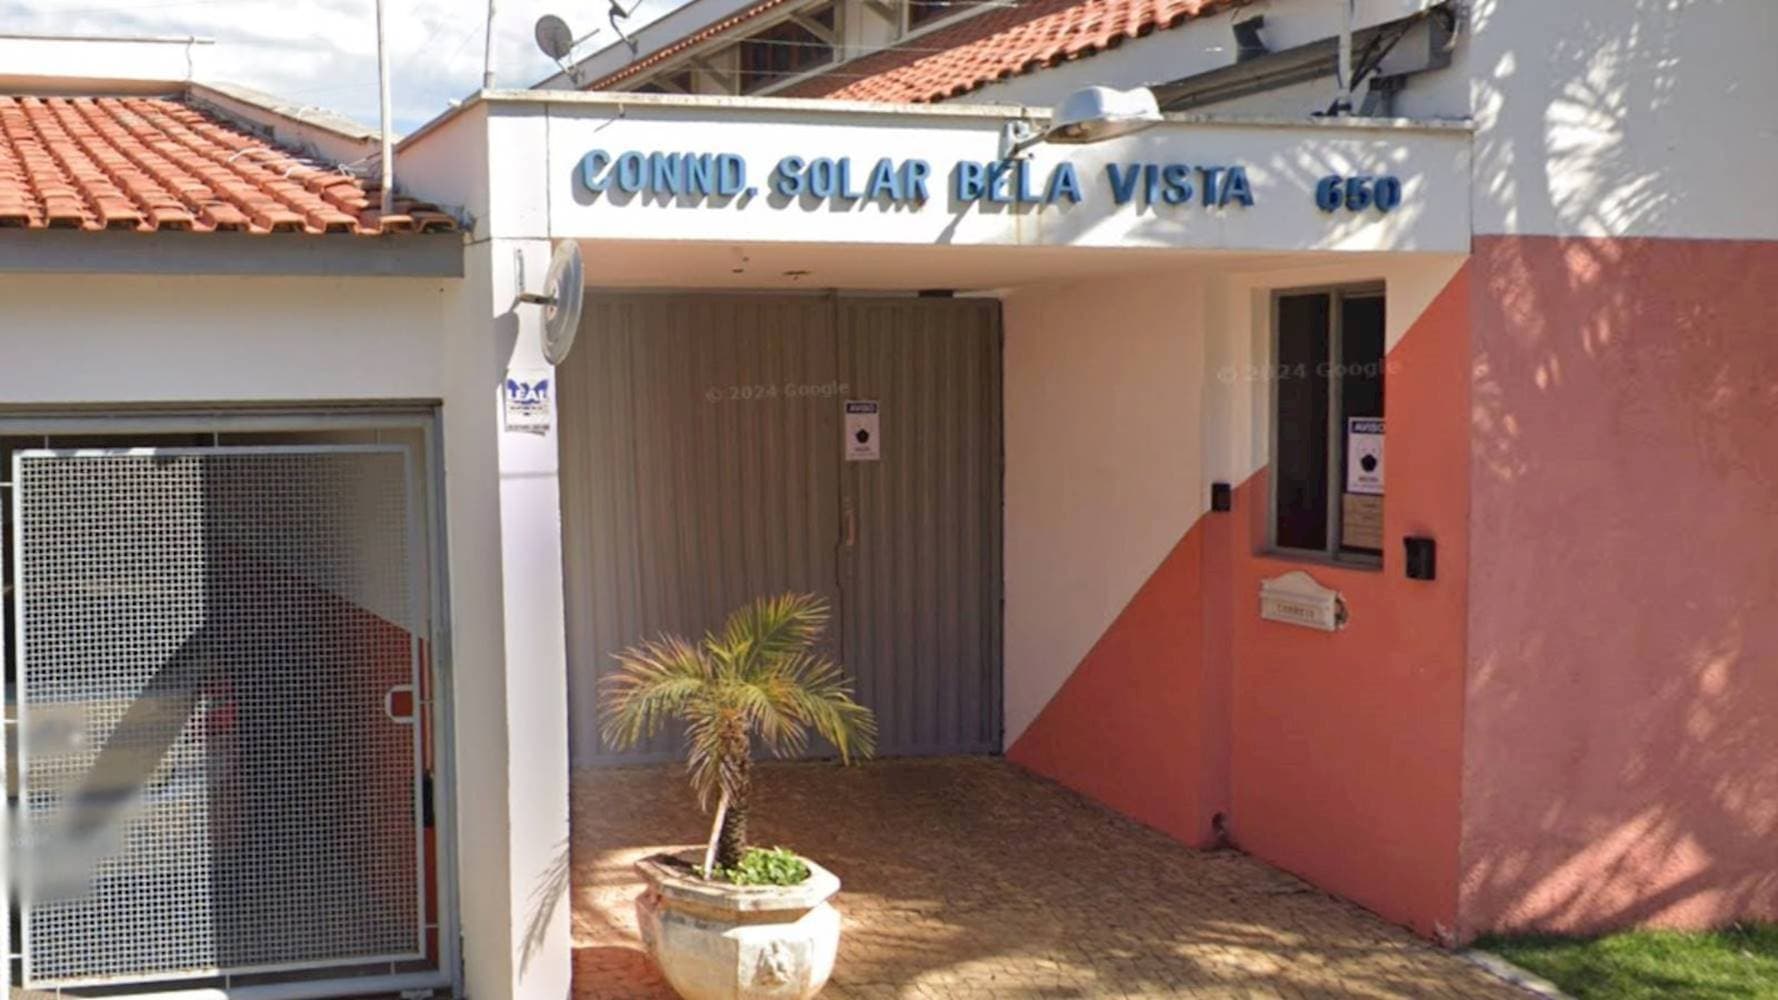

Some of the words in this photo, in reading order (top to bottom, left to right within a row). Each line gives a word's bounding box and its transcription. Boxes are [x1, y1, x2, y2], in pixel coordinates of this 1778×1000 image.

[580, 148, 758, 199] CONND.
[777, 155, 931, 206] SOLAR
[956, 159, 1081, 206] BELA
[1107, 163, 1254, 208] VISTA
[1315, 174, 1402, 213] 650
